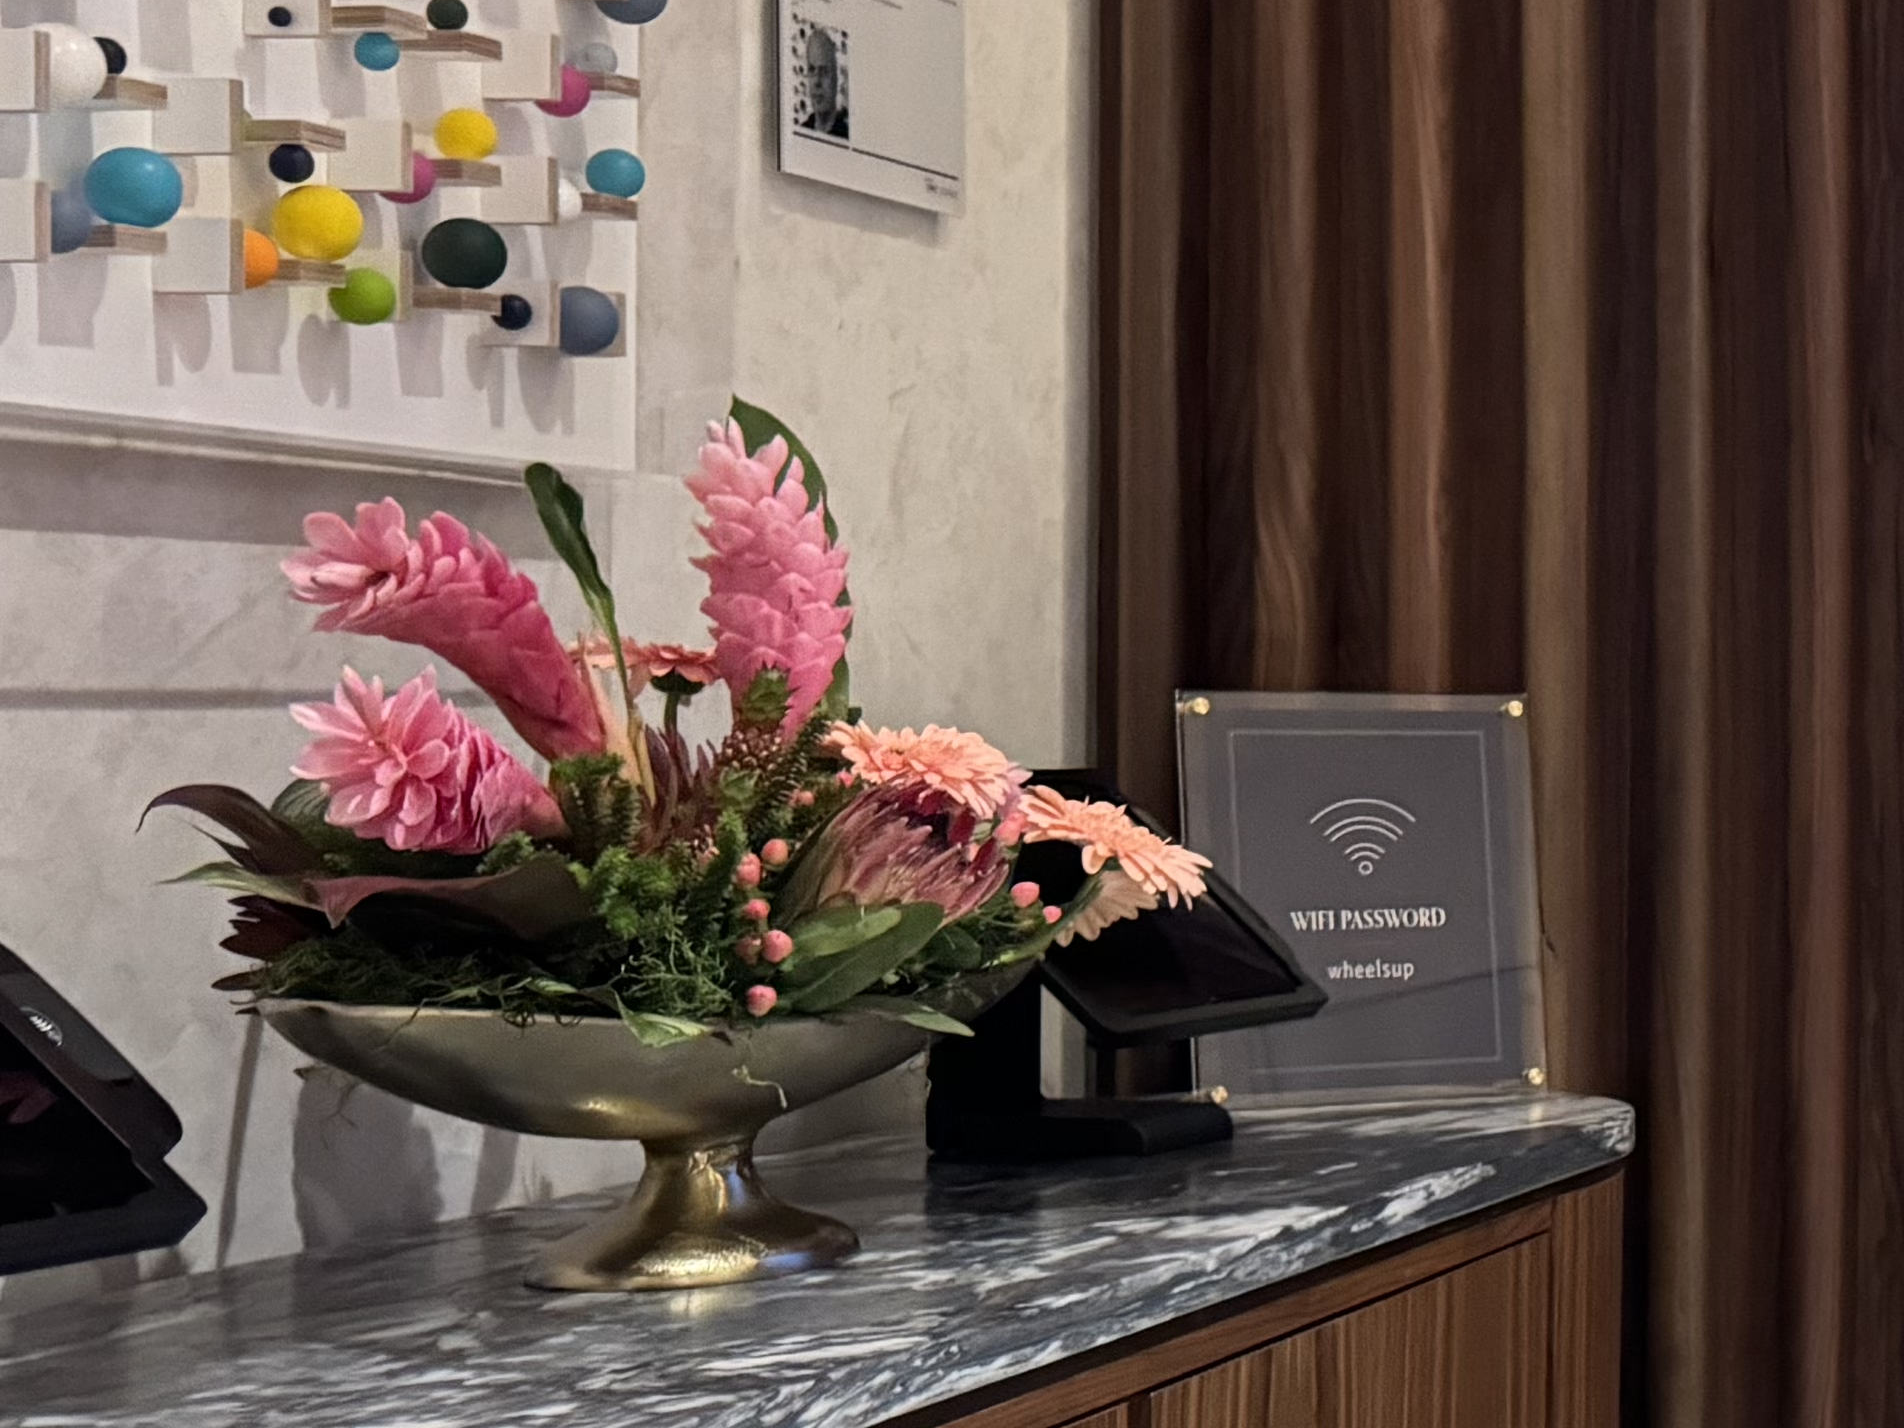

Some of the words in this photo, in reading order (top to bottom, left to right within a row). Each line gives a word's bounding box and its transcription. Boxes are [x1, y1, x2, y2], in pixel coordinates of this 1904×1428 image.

[1289, 910, 1335, 932] WIFI
[1340, 907, 1447, 931] PASSWORD
[1327, 958, 1415, 981] wheelsup
